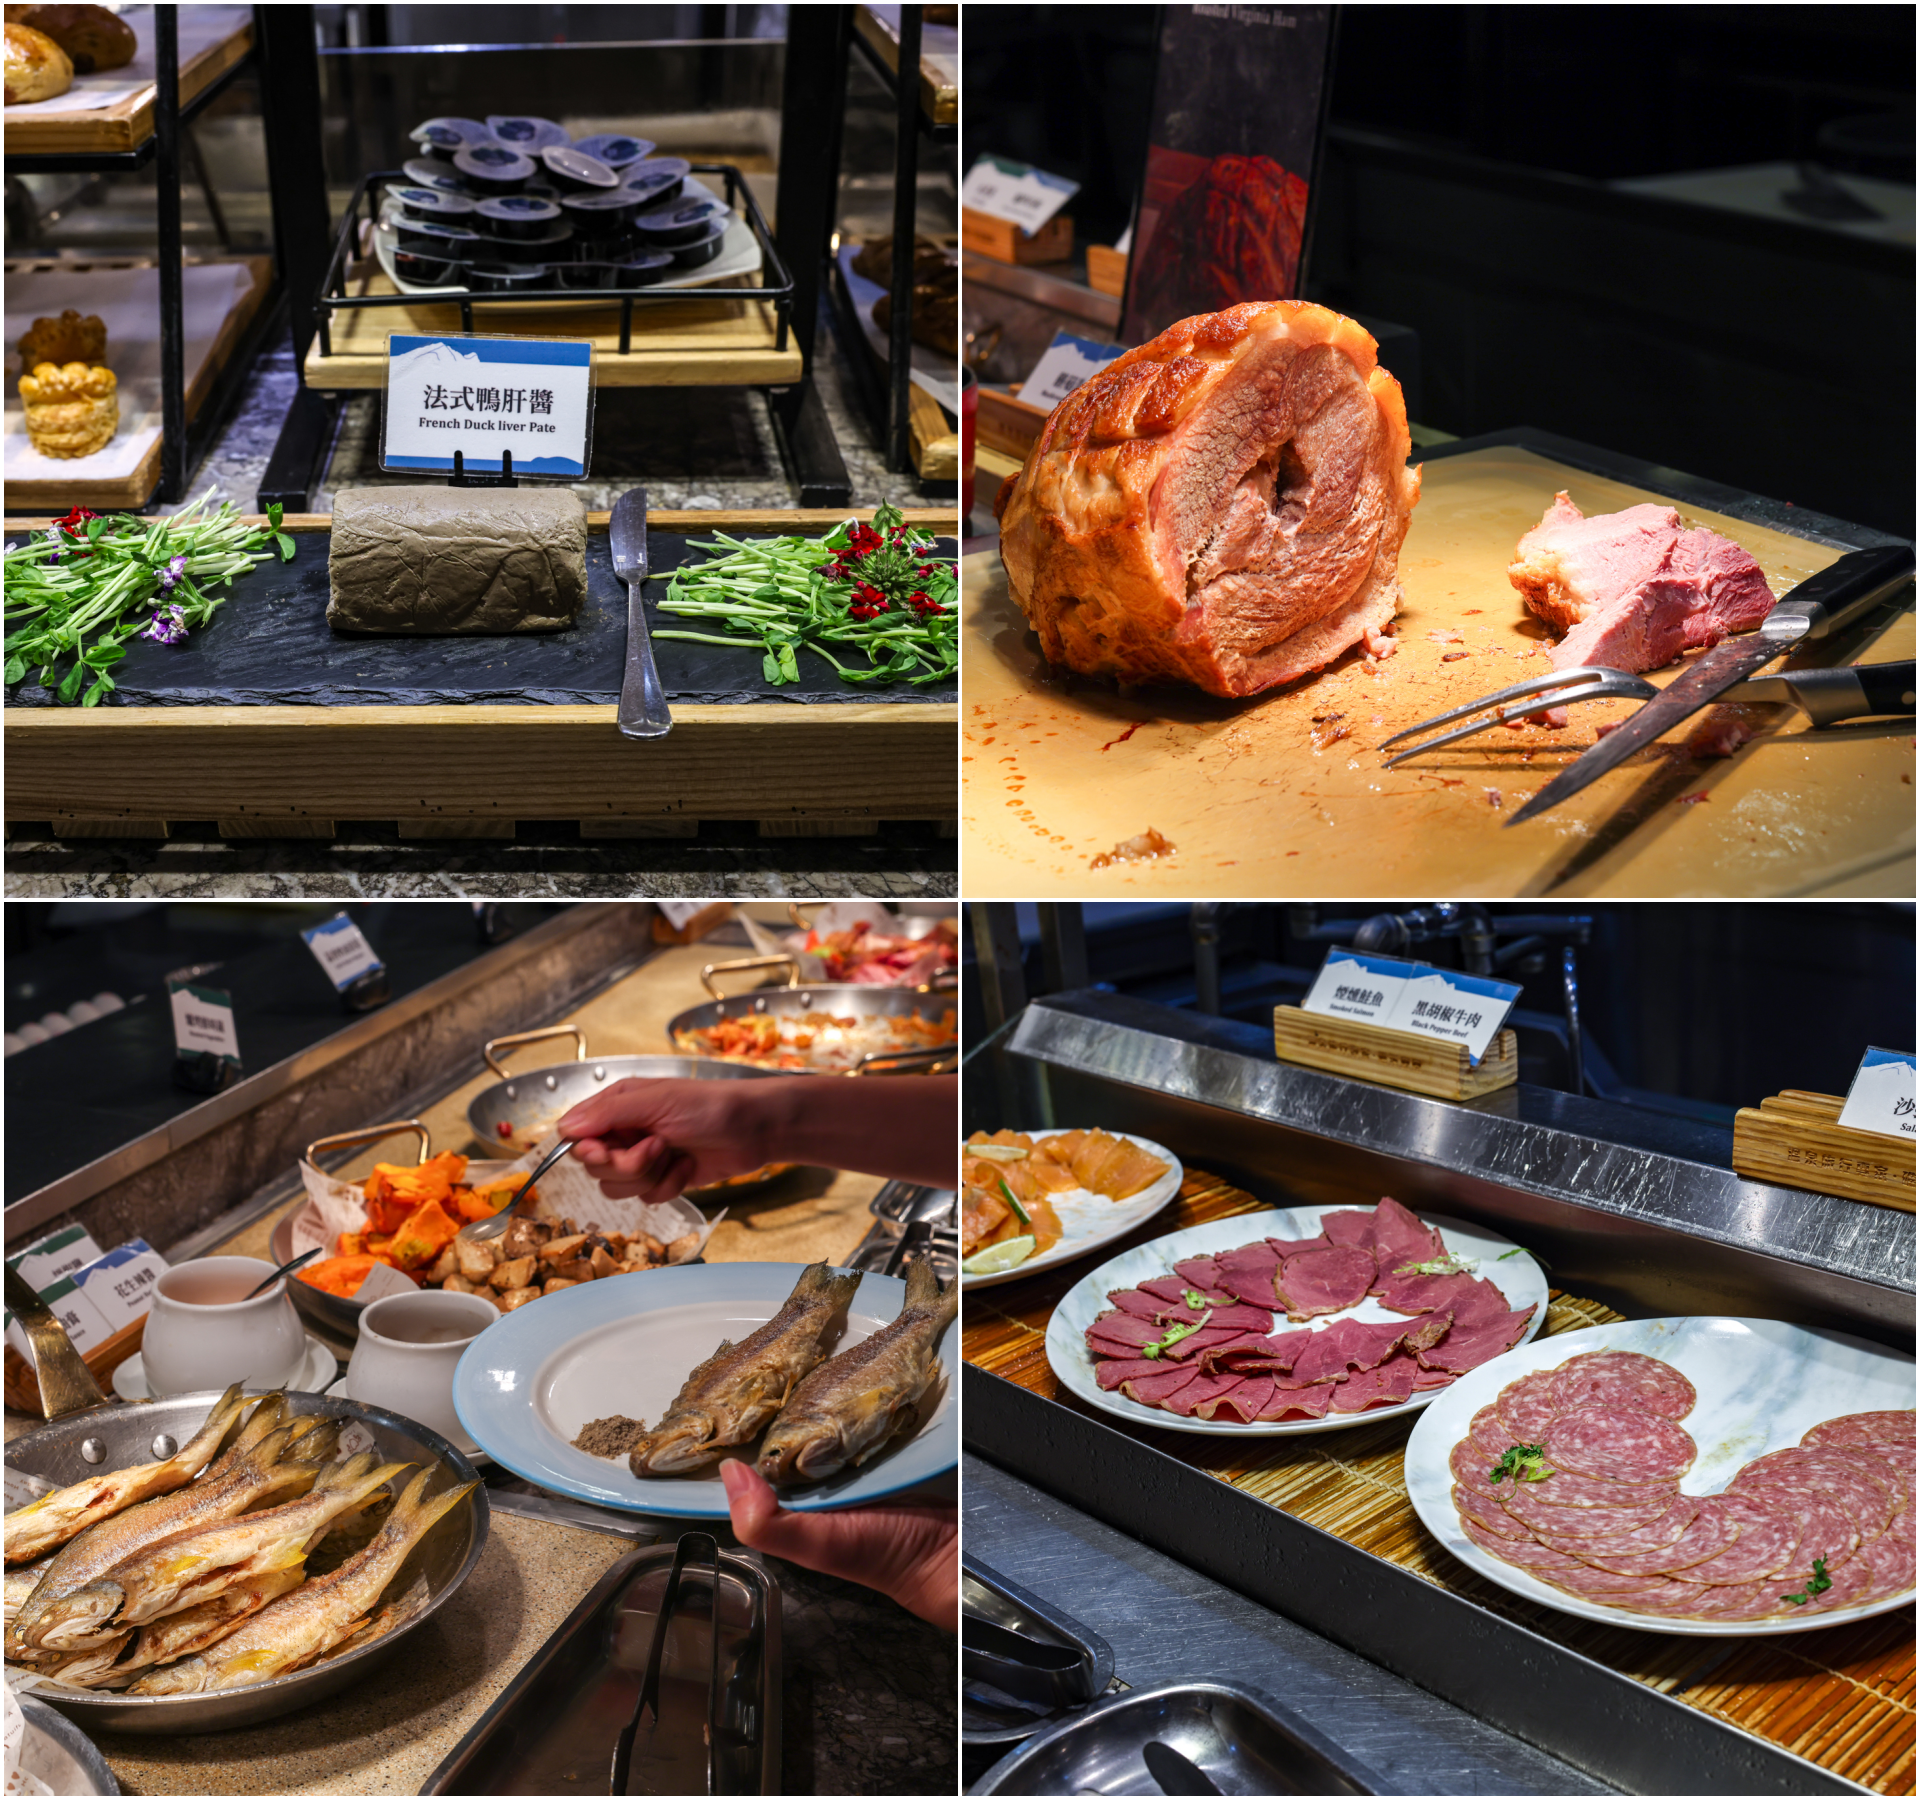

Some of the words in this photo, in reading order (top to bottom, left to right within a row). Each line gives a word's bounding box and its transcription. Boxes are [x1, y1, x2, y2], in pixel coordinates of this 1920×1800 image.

[423, 384, 554, 415] 法式鴨肝醬
[419, 417, 460, 429] French
[464, 419, 495, 431] Duck
[498, 420, 526, 432] liver
[529, 422, 556, 433] Pate
[1329, 1002, 1353, 1014] Smoked
[1353, 1006, 1375, 1017] Salmon
[1411, 1000, 1482, 1028] 黑胡椒牛肉
[1411, 1019, 1429, 1029] Black
[1429, 1023, 1452, 1034] Pepper
[1452, 1029, 1469, 1038] Beef
[1893, 1097, 1916, 1118] 沙
